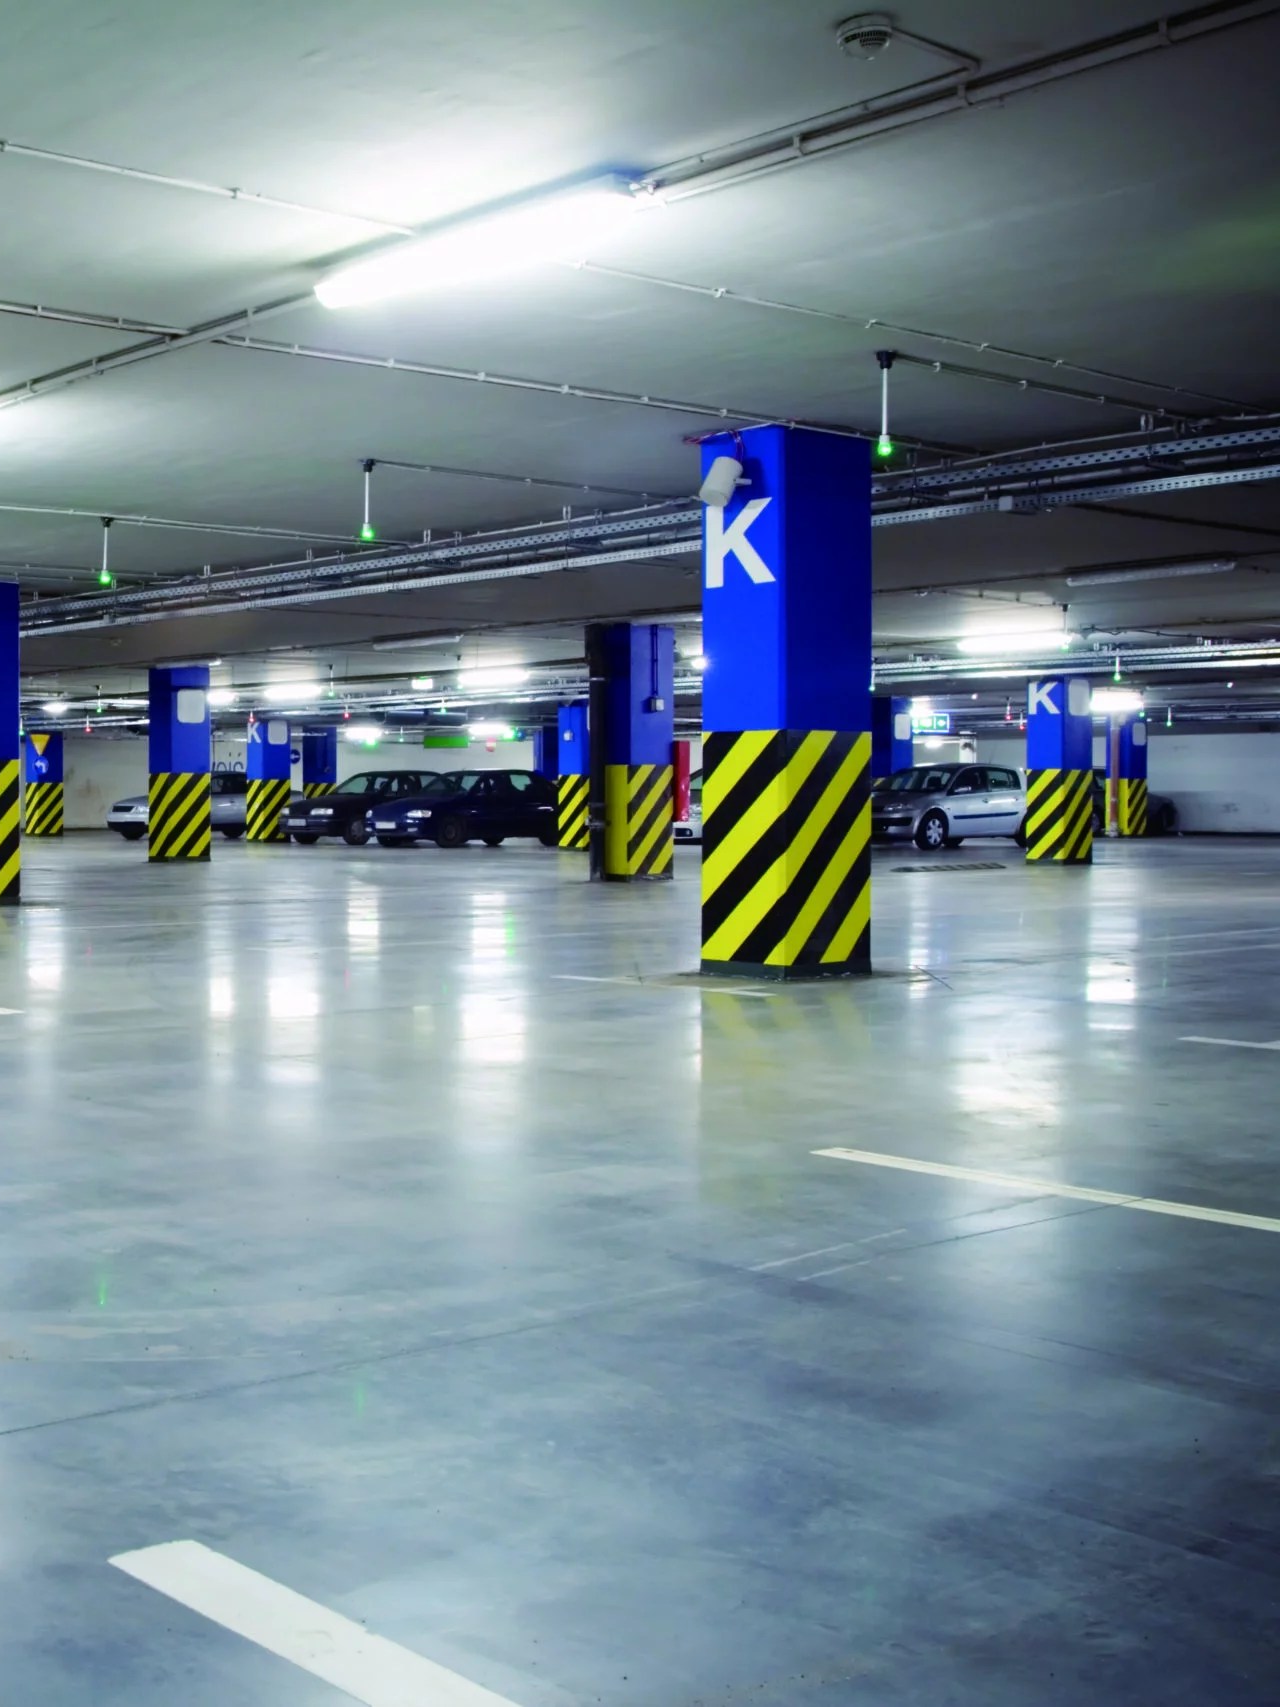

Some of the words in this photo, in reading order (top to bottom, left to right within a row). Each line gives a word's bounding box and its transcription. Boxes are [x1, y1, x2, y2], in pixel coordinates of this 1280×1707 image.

[705, 497, 776, 589] K
[1028, 681, 1061, 715] K
[247, 721, 261, 743] K
